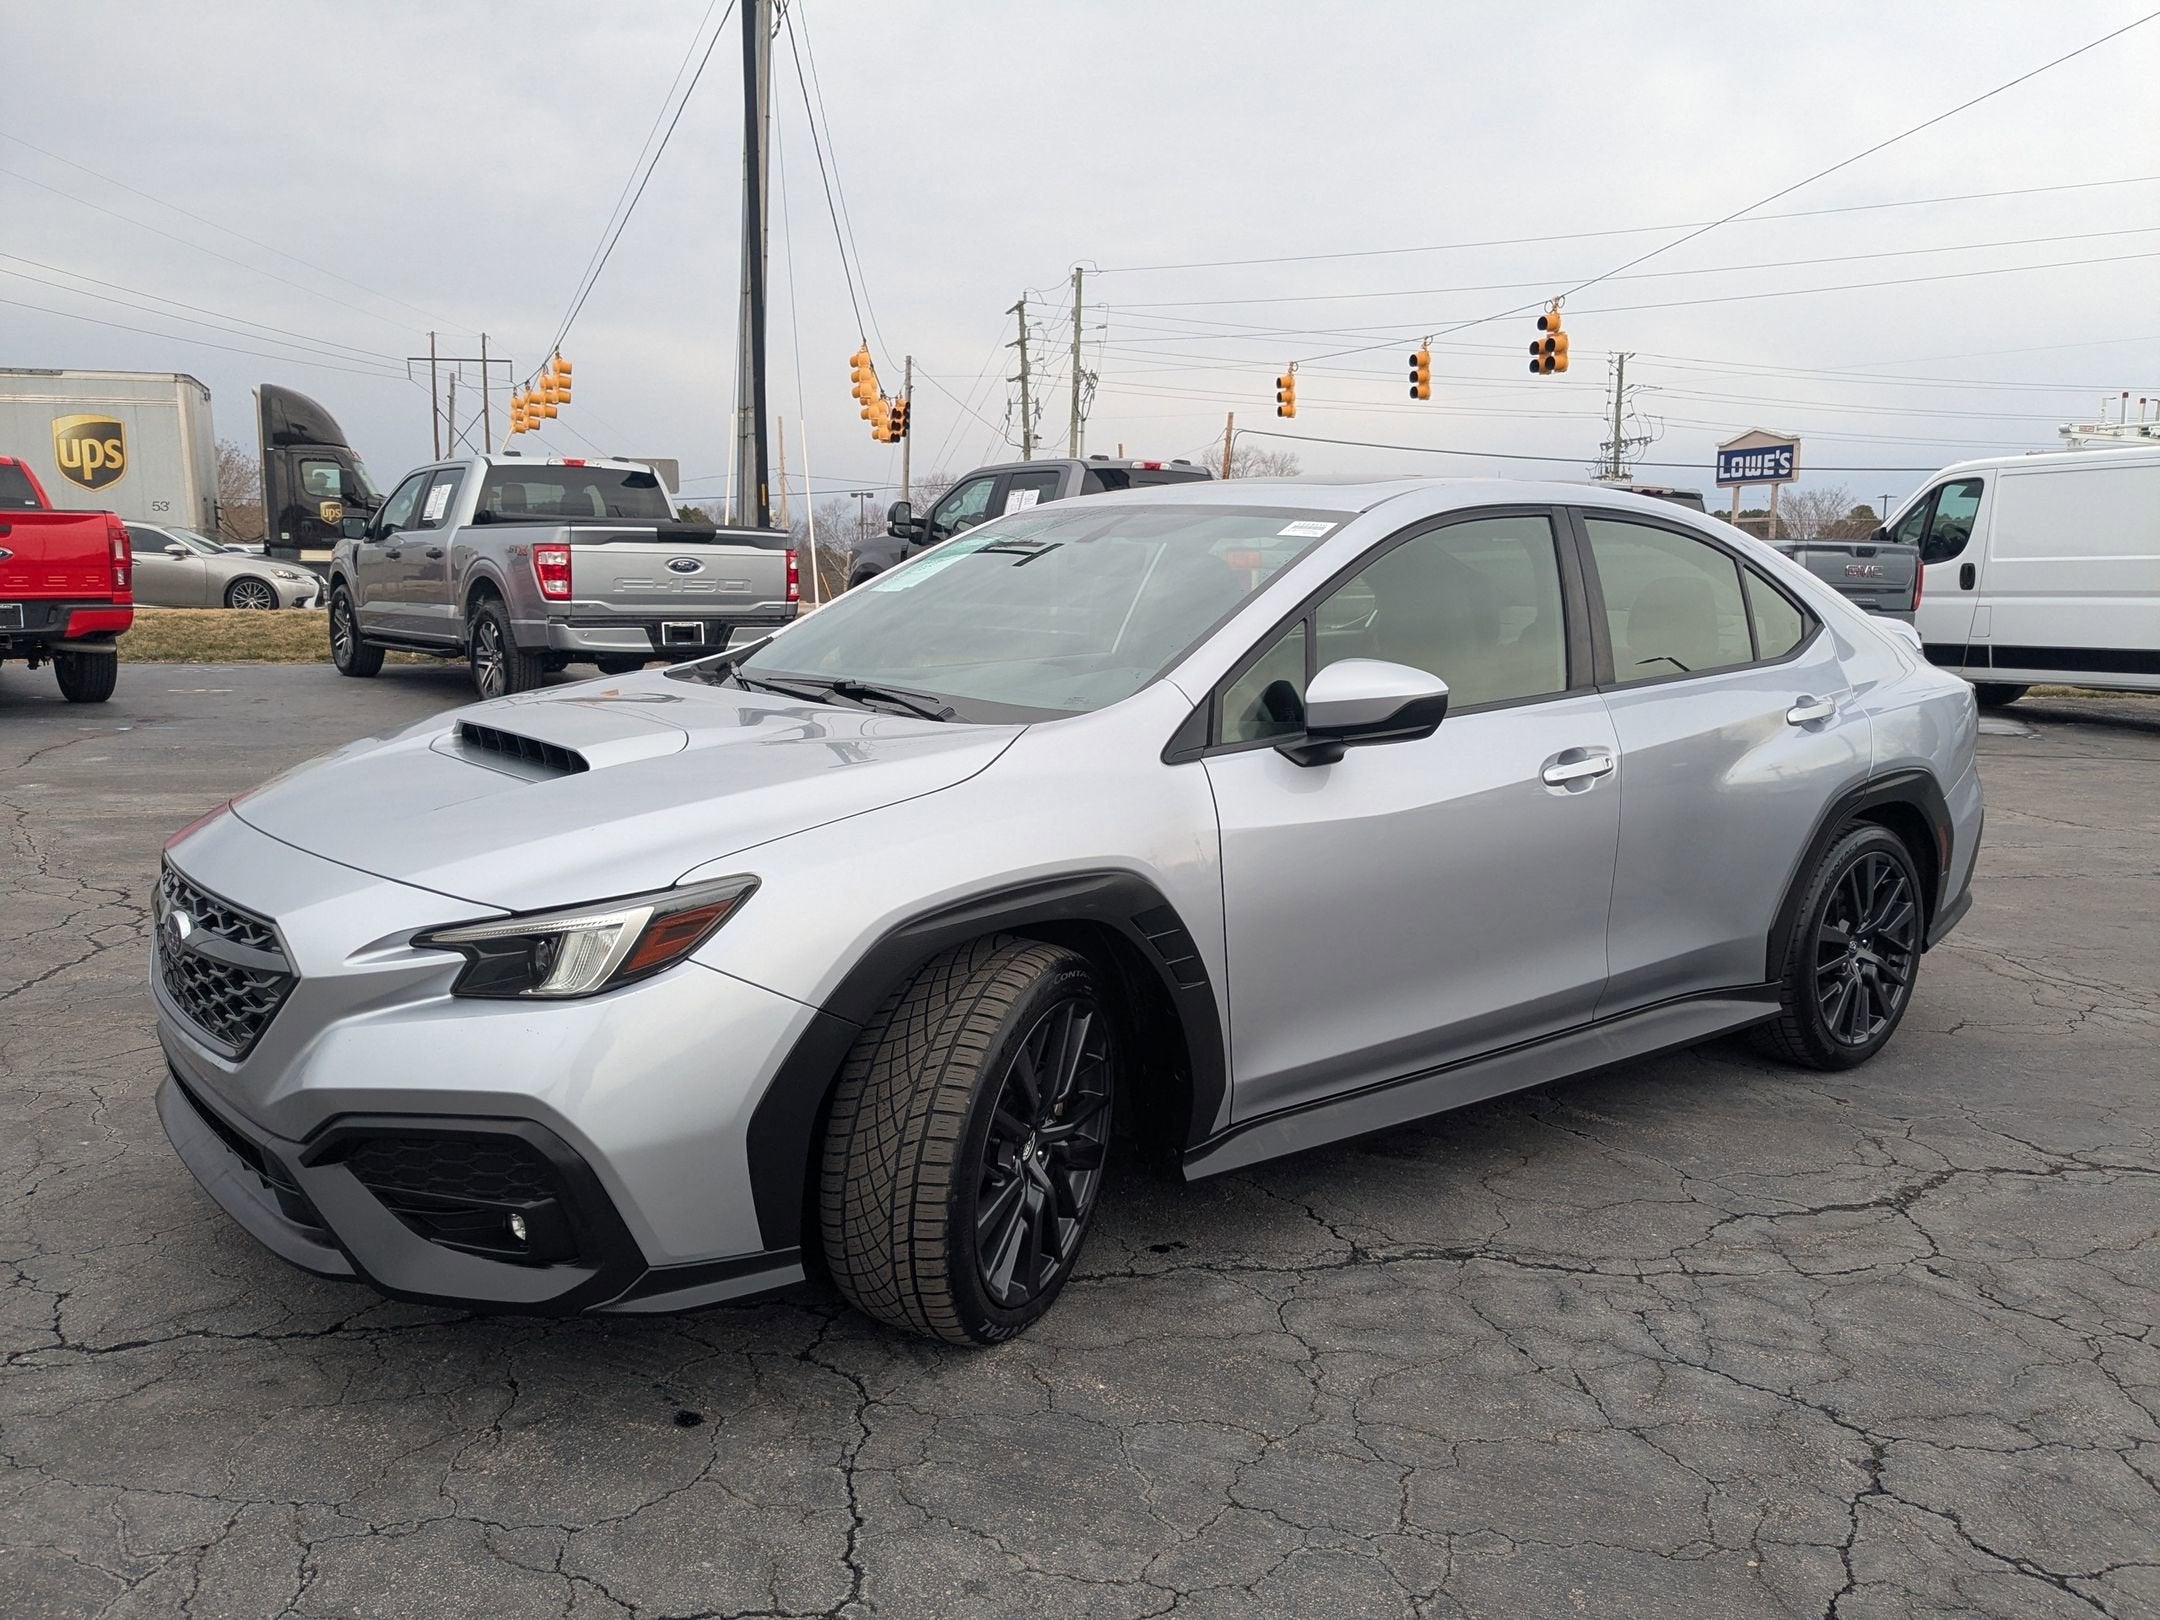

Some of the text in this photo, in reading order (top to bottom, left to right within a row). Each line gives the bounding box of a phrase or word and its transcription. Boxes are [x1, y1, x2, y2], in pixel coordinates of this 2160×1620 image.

[58, 438, 124, 480] ups
[1718, 449, 1792, 479] LOWE'S
[322, 508, 341, 521] ups
[1846, 564, 1884, 577] GMC
[613, 577, 752, 593] F-150
